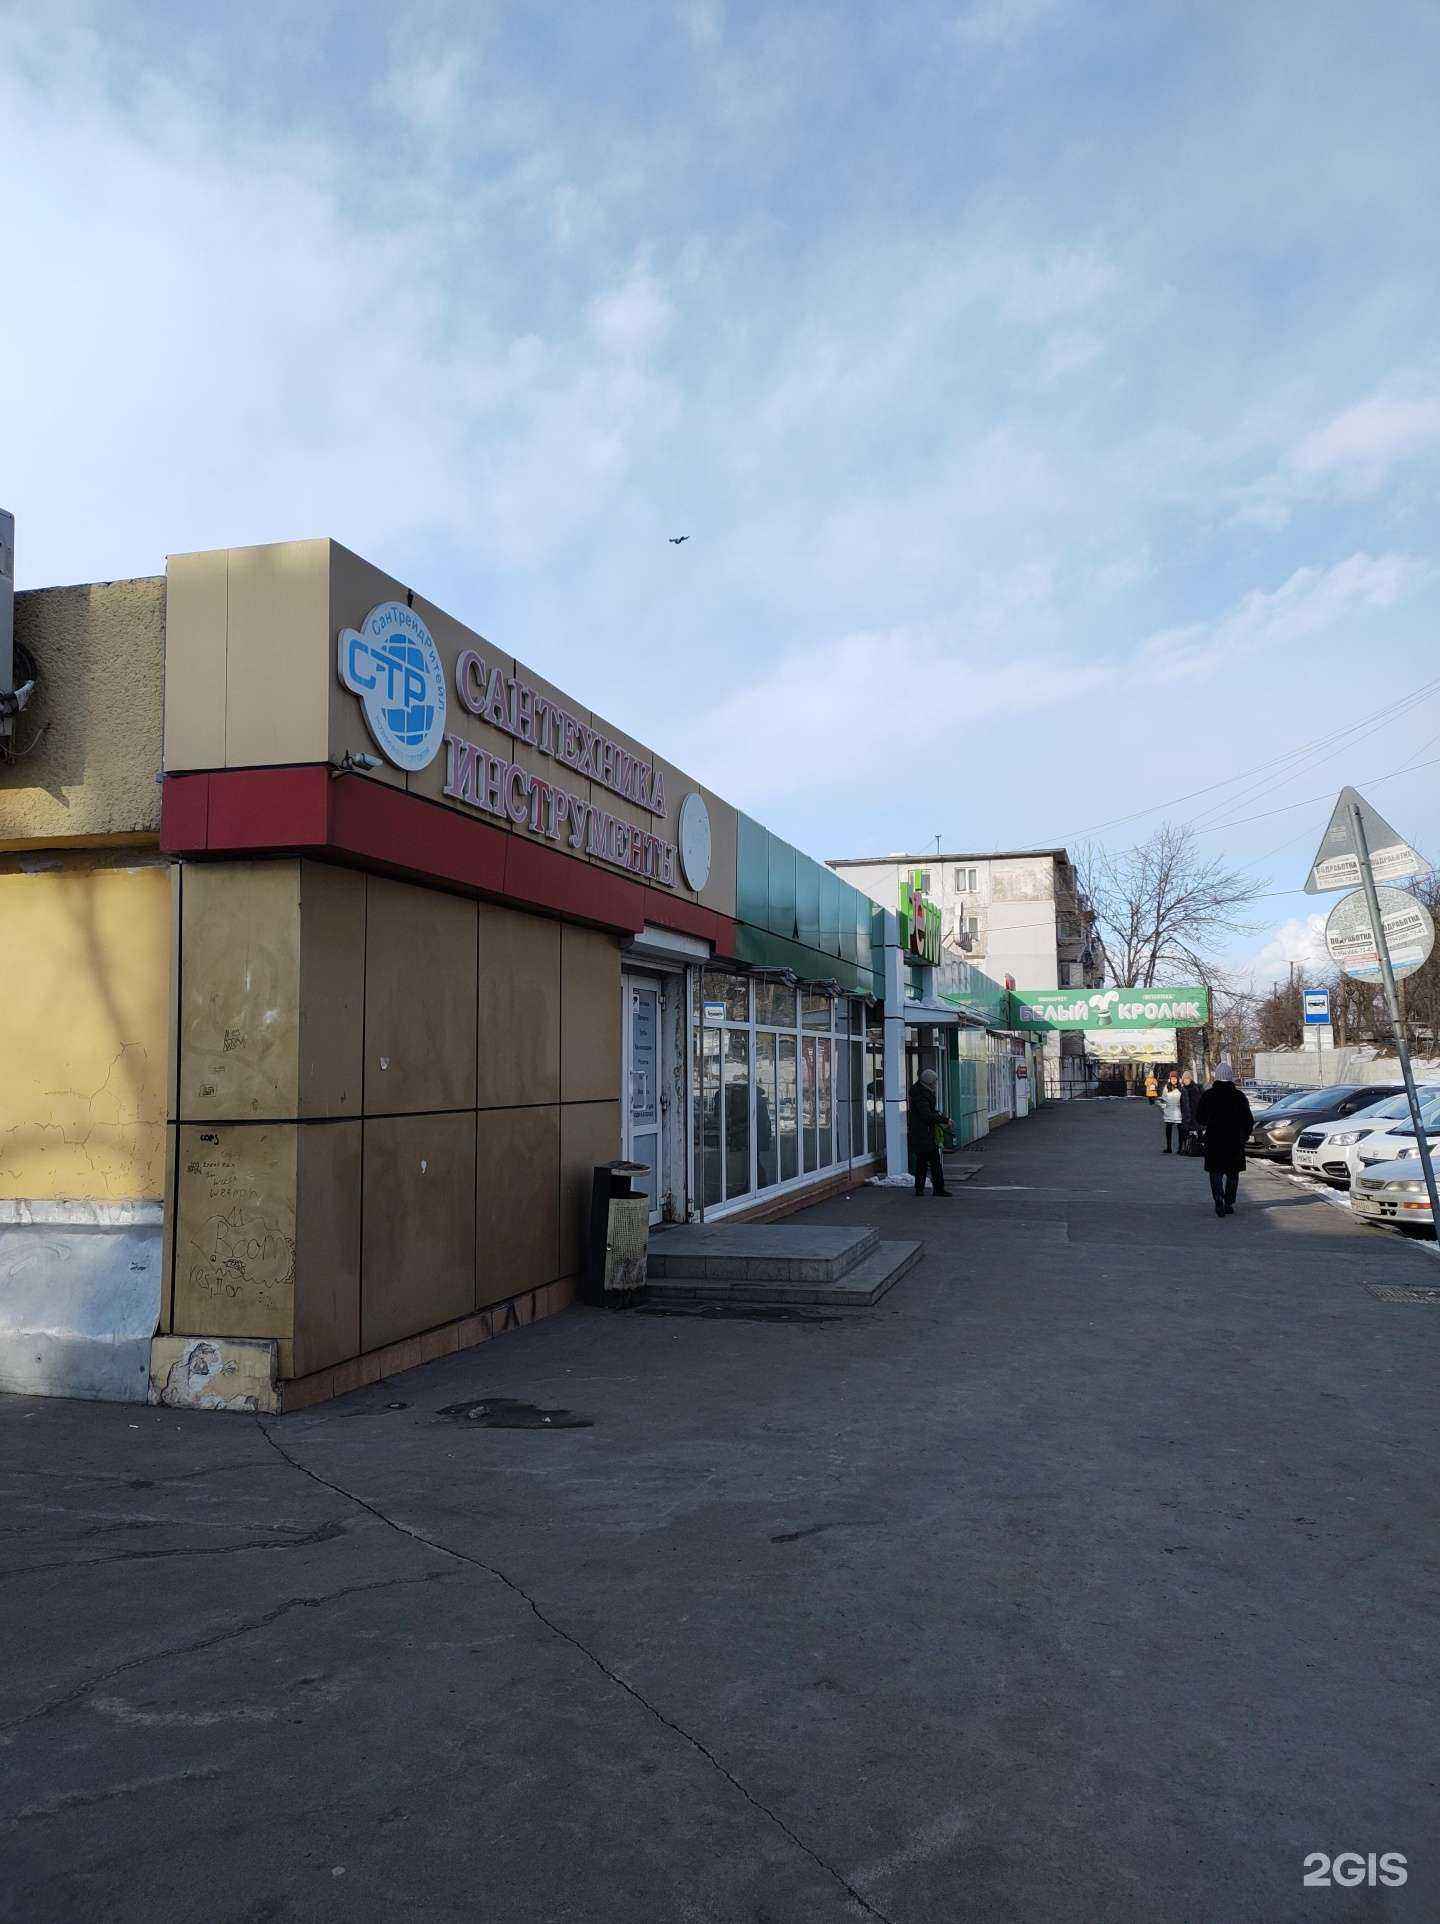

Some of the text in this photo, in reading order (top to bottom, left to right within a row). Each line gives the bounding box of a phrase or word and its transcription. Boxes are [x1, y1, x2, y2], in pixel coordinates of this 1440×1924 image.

[349, 638, 427, 709] СТР
[456, 649, 667, 818] САНТЕХНИКА
[443, 733, 680, 888] ИНСТРУМЕНТЫ
[1019, 1002, 1201, 1022] БЕЛЫЙ КРОЛИК
